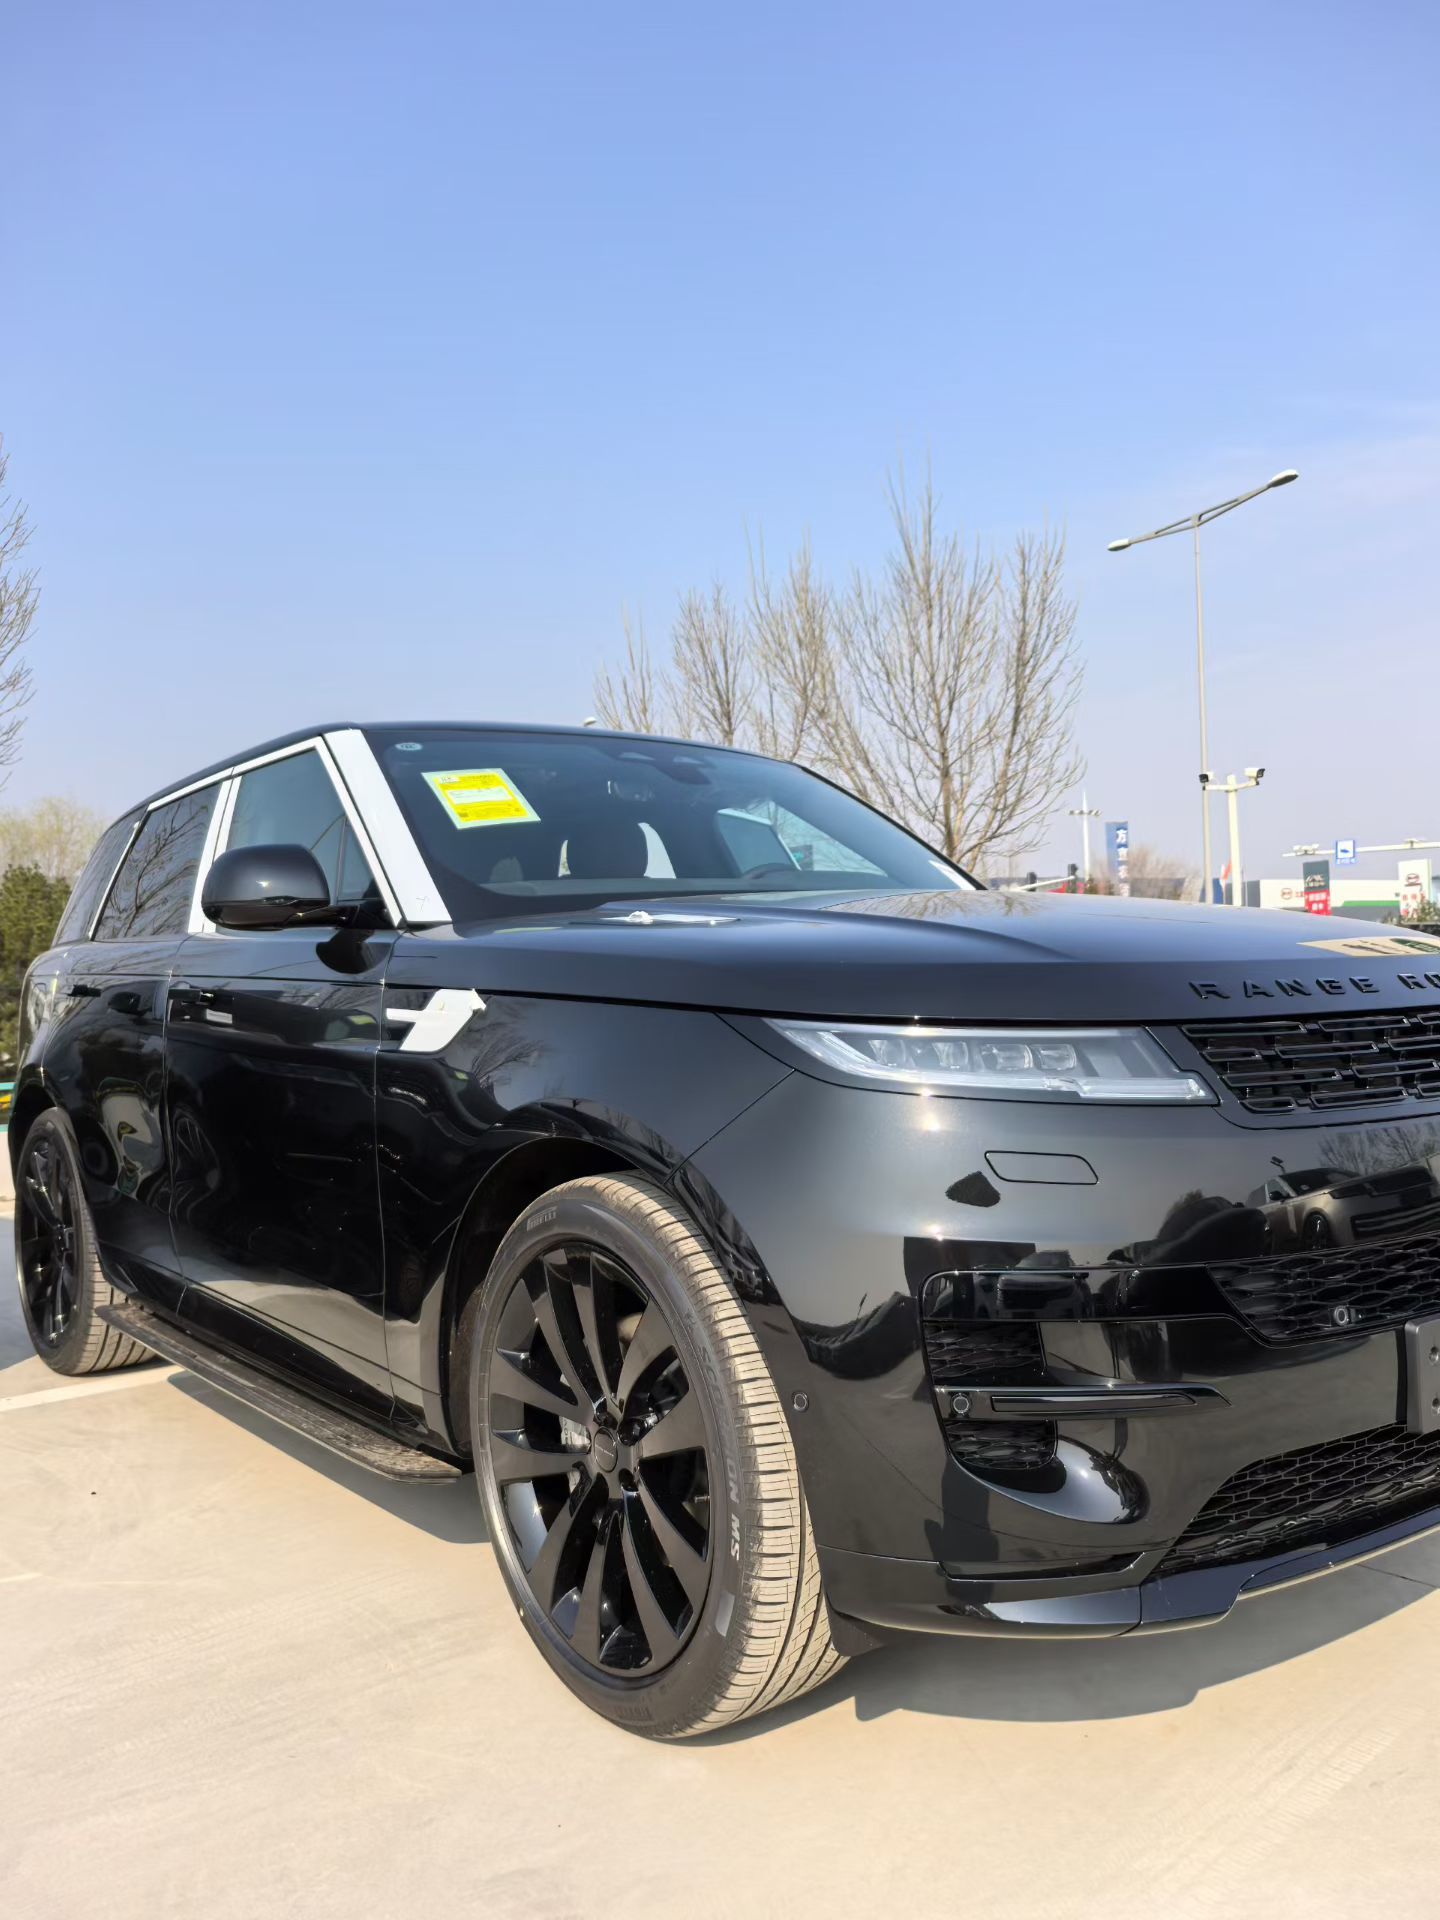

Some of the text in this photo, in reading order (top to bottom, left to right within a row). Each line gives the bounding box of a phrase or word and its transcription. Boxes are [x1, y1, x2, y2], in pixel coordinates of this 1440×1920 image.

[1188, 975, 1381, 1000] RANGE
[701, 1345, 741, 1561] SCOION MS
